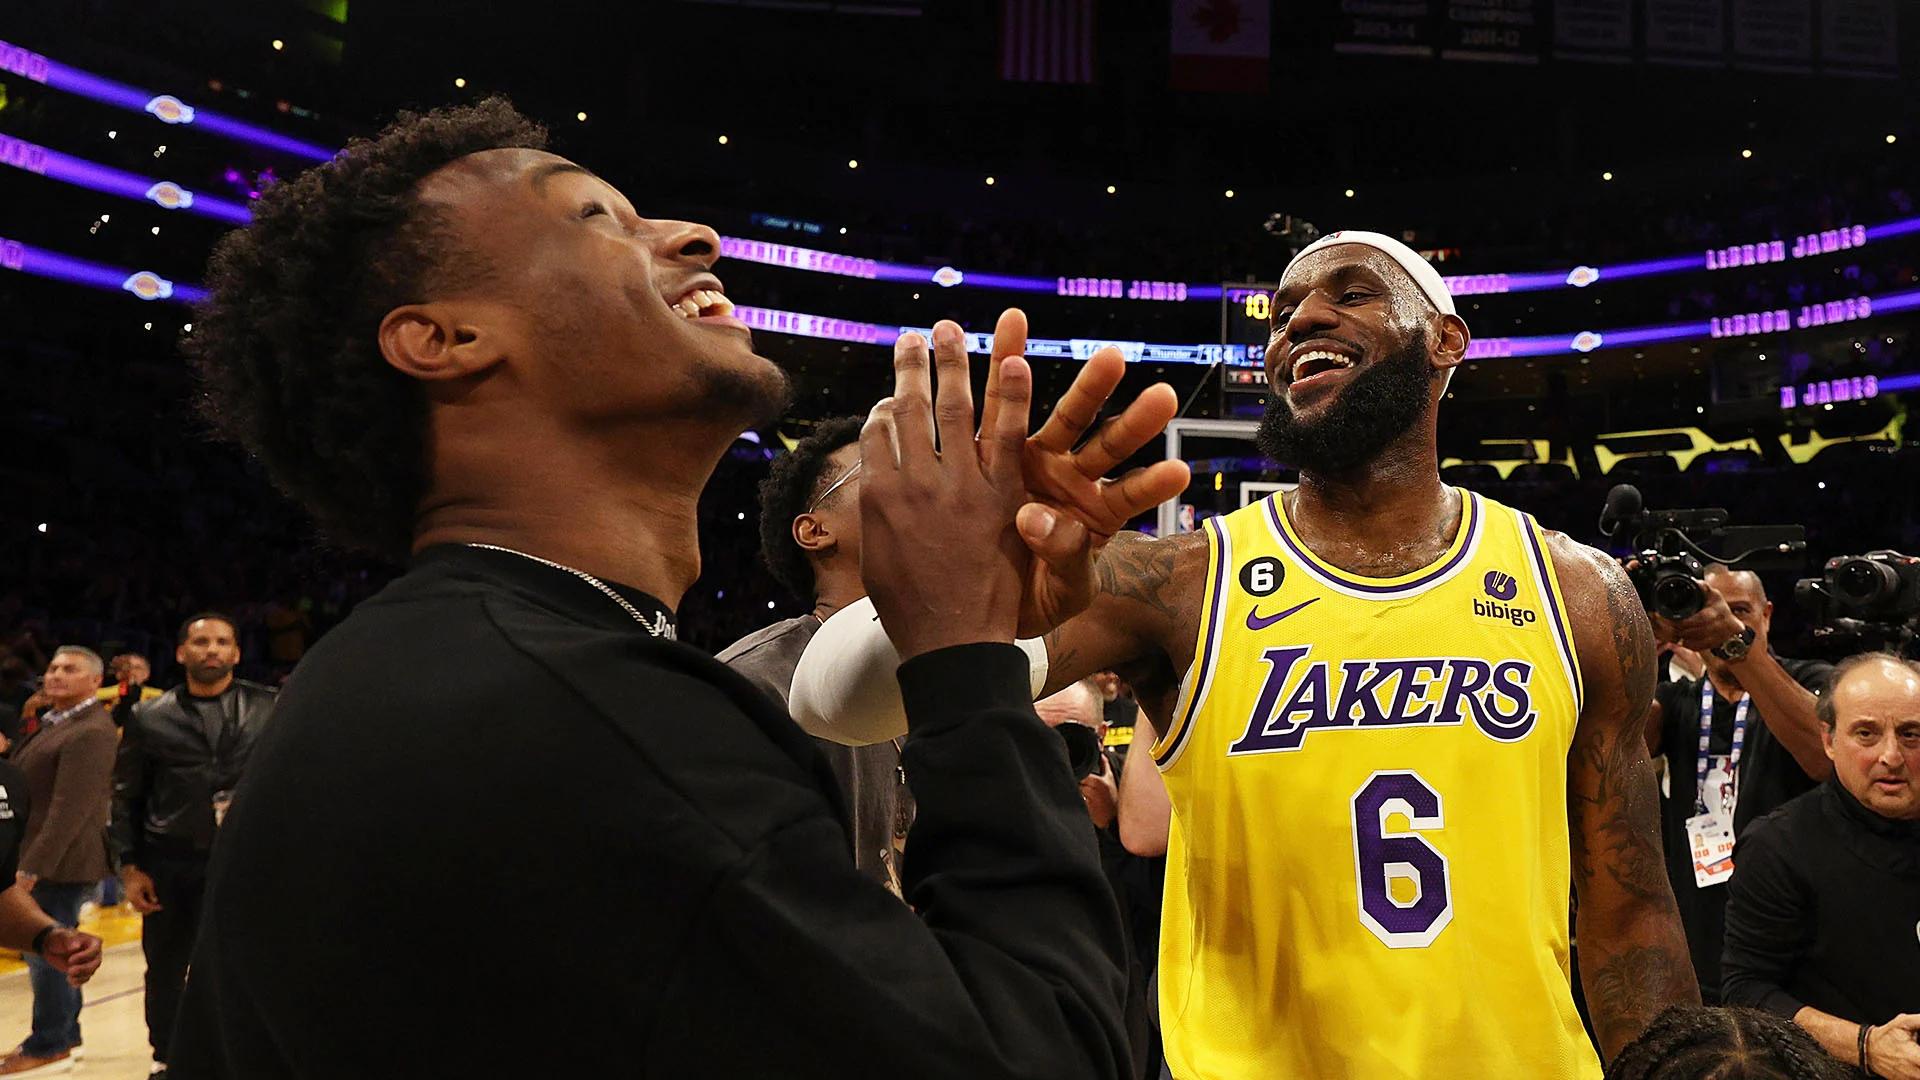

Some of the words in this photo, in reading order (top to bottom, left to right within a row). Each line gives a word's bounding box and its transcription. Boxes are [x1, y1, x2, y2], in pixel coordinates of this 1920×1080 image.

[1706, 241, 1785, 269] LEBRON
[1792, 225, 1867, 258] JAMES
[1057, 277, 1122, 298] LEBRON
[1128, 280, 1187, 301] JAMES
[1711, 310, 1790, 338] LEBRON
[1797, 296, 1871, 328] JAMES
[1803, 375, 1878, 405] JAMES
[1250, 560, 1274, 591] 6
[1473, 598, 1536, 627] bibigo
[1227, 644, 1539, 756] LAKERS
[1349, 769, 1453, 949] 6
